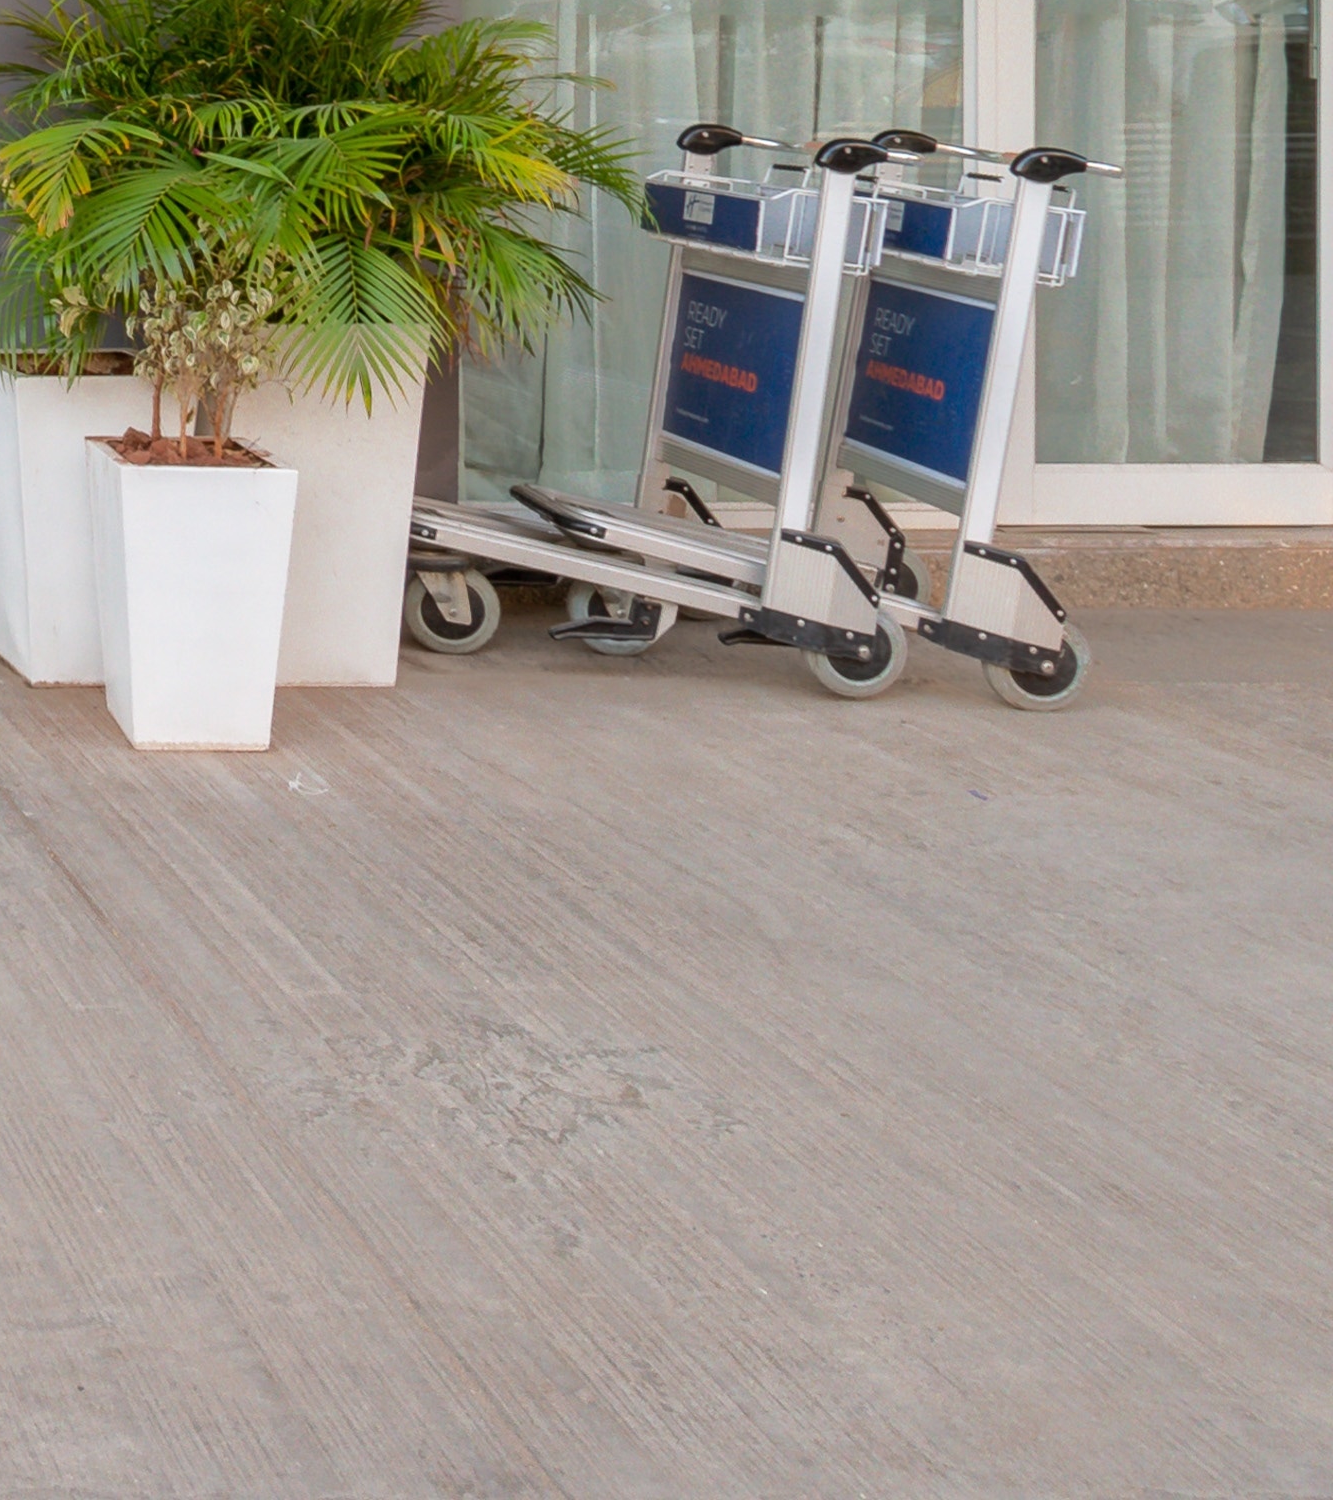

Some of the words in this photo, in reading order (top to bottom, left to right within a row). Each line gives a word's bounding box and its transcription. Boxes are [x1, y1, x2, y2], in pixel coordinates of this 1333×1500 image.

[687, 300, 728, 329] READY
[873, 307, 916, 336] READY
[683, 326, 705, 350] SET
[869, 332, 892, 357] SET
[680, 352, 758, 393] AHMEDABAD
[865, 360, 946, 401] AHMEDABAD
